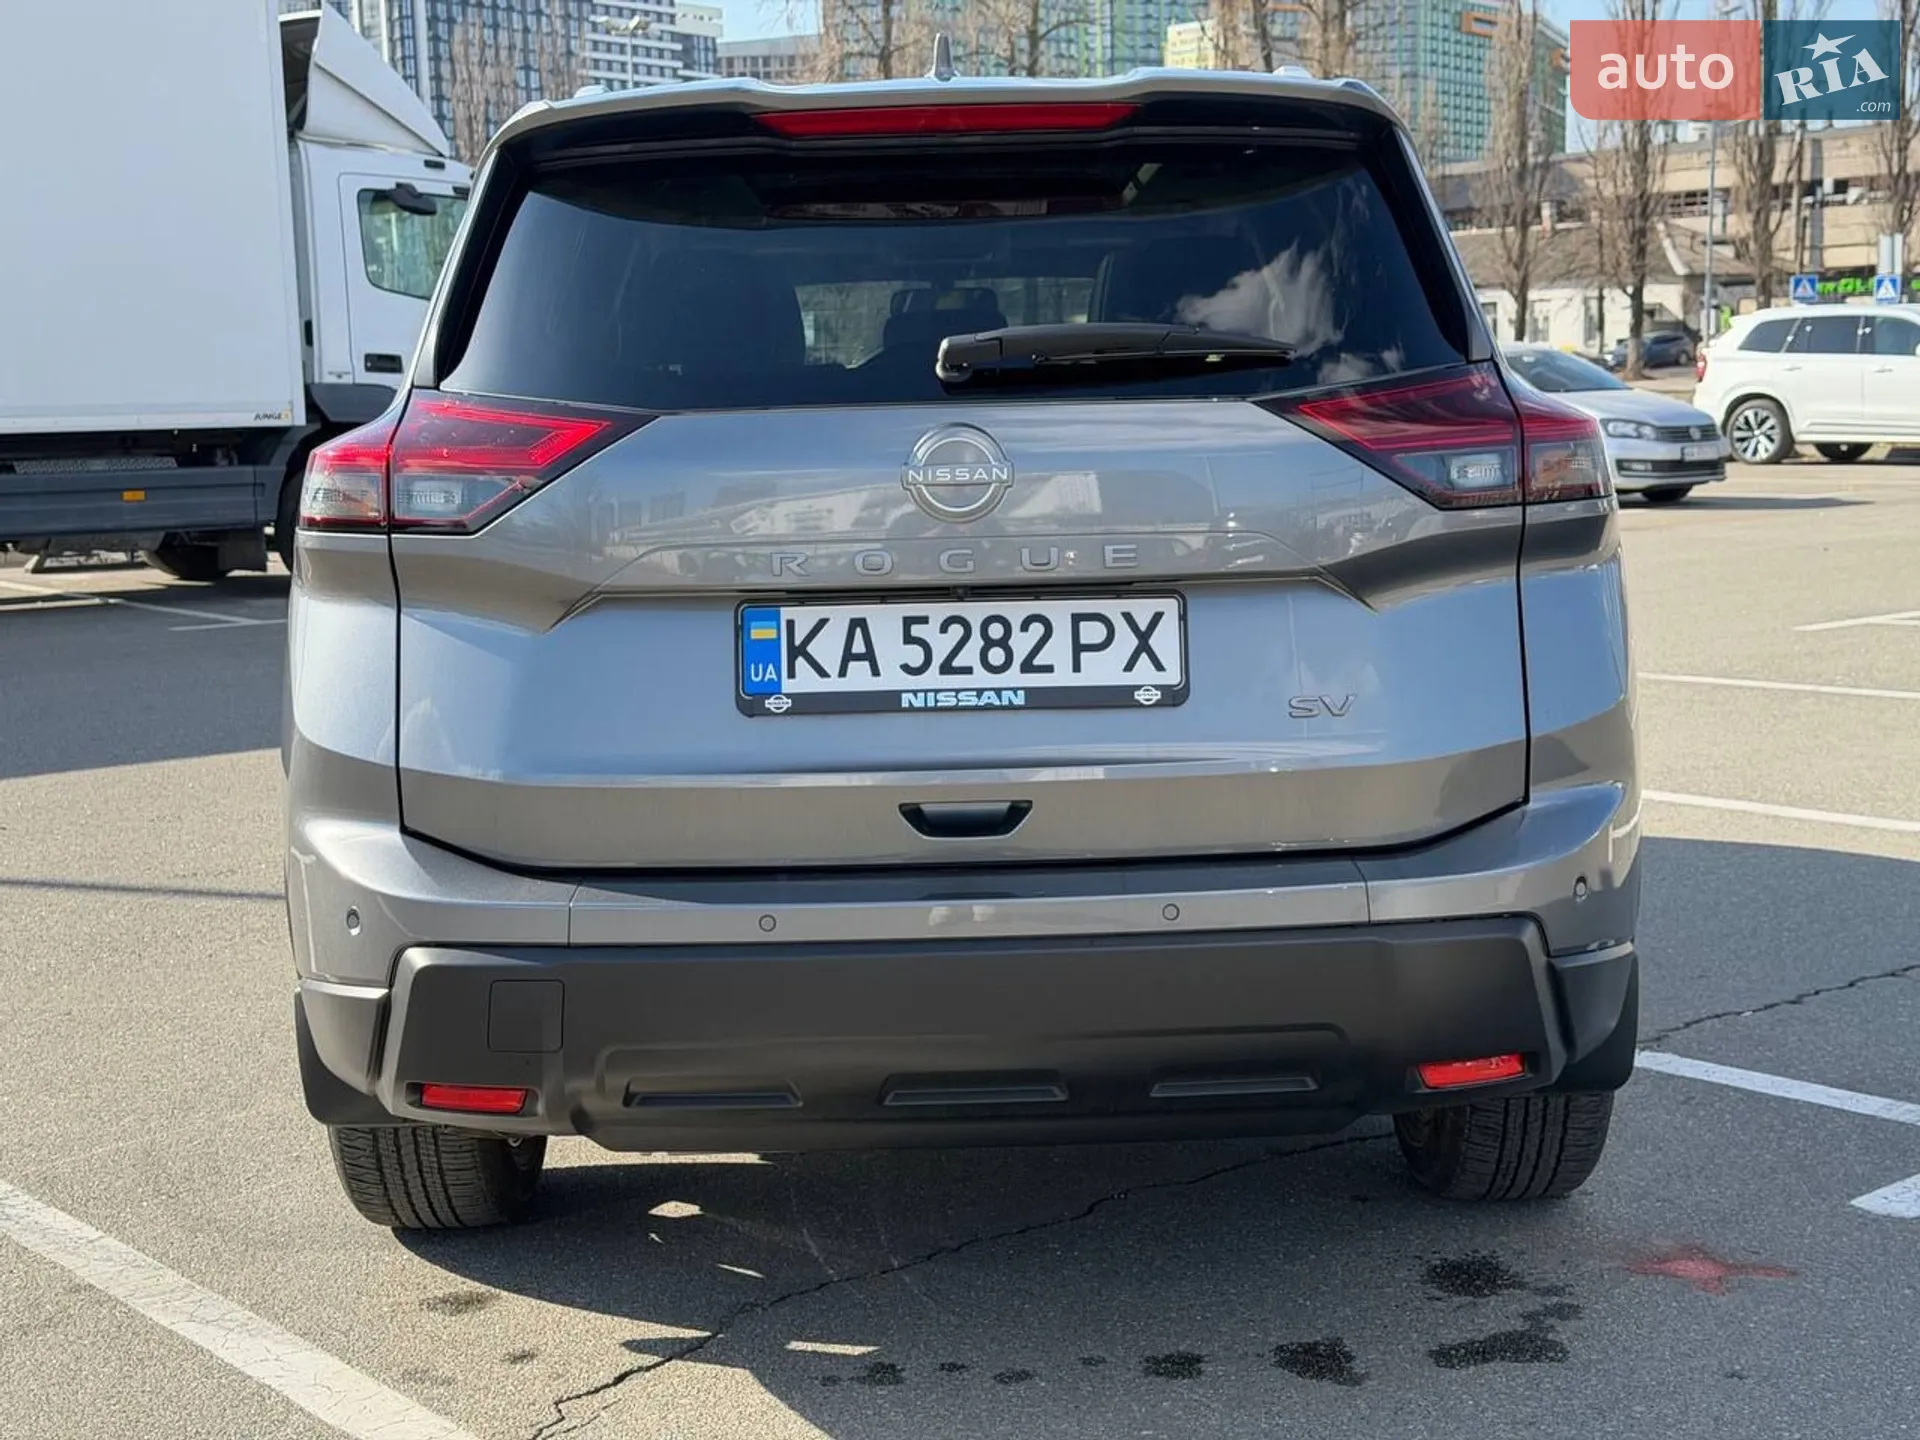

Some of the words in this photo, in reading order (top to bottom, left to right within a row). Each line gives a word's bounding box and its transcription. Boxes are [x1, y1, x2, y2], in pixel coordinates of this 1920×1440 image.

[908, 466, 1008, 482] NISSAN
[769, 543, 1139, 577] ROGUE
[785, 617, 882, 680] KA
[899, 613, 1055, 677] 5282
[1070, 611, 1167, 674] PX
[751, 663, 779, 683] UA
[901, 688, 1026, 708] NISSAN
[1288, 694, 1358, 719] SV
